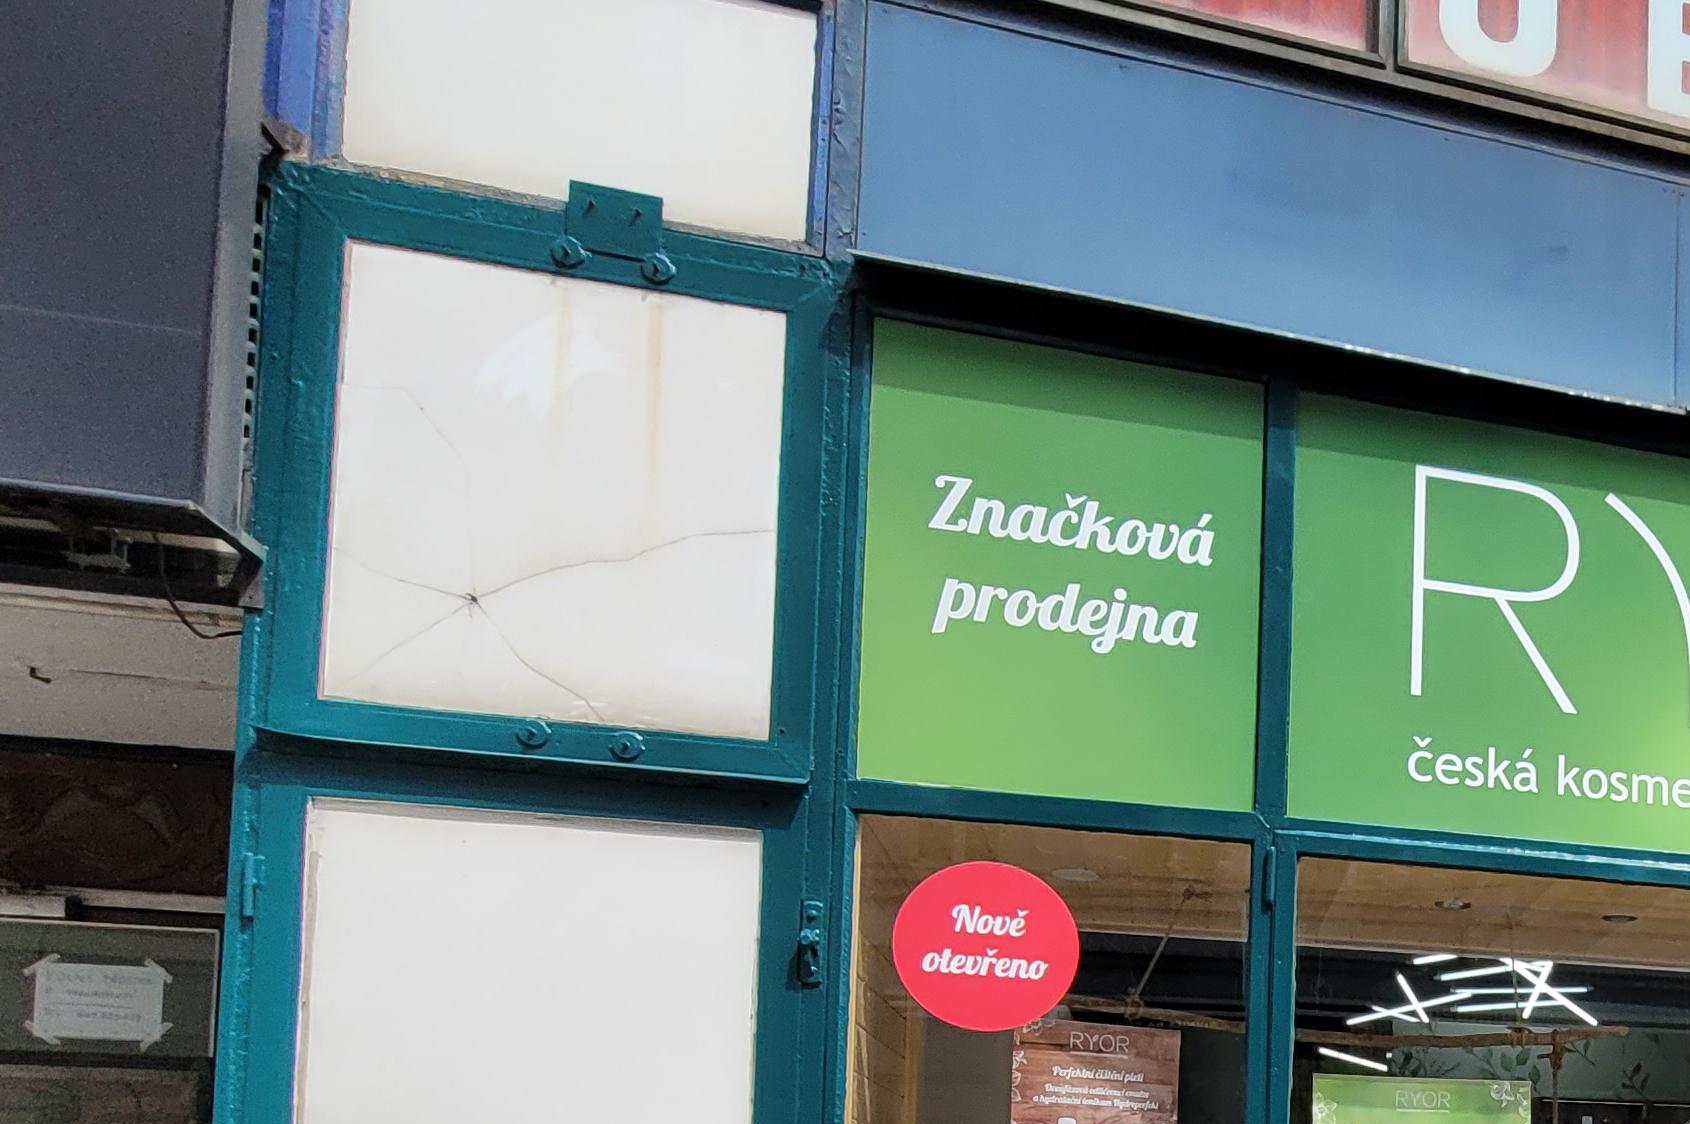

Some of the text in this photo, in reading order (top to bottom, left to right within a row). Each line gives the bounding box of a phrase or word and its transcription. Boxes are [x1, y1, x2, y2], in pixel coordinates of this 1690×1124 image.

[928, 474, 1215, 568] Značková
[930, 576, 1198, 654] prodejna
[1407, 736, 1538, 794] česká
[951, 903, 1029, 938] Nově
[921, 948, 1049, 980] otevřeno
[1069, 1031, 1130, 1053] RYOR
[1396, 1091, 1451, 1108] RYOR
